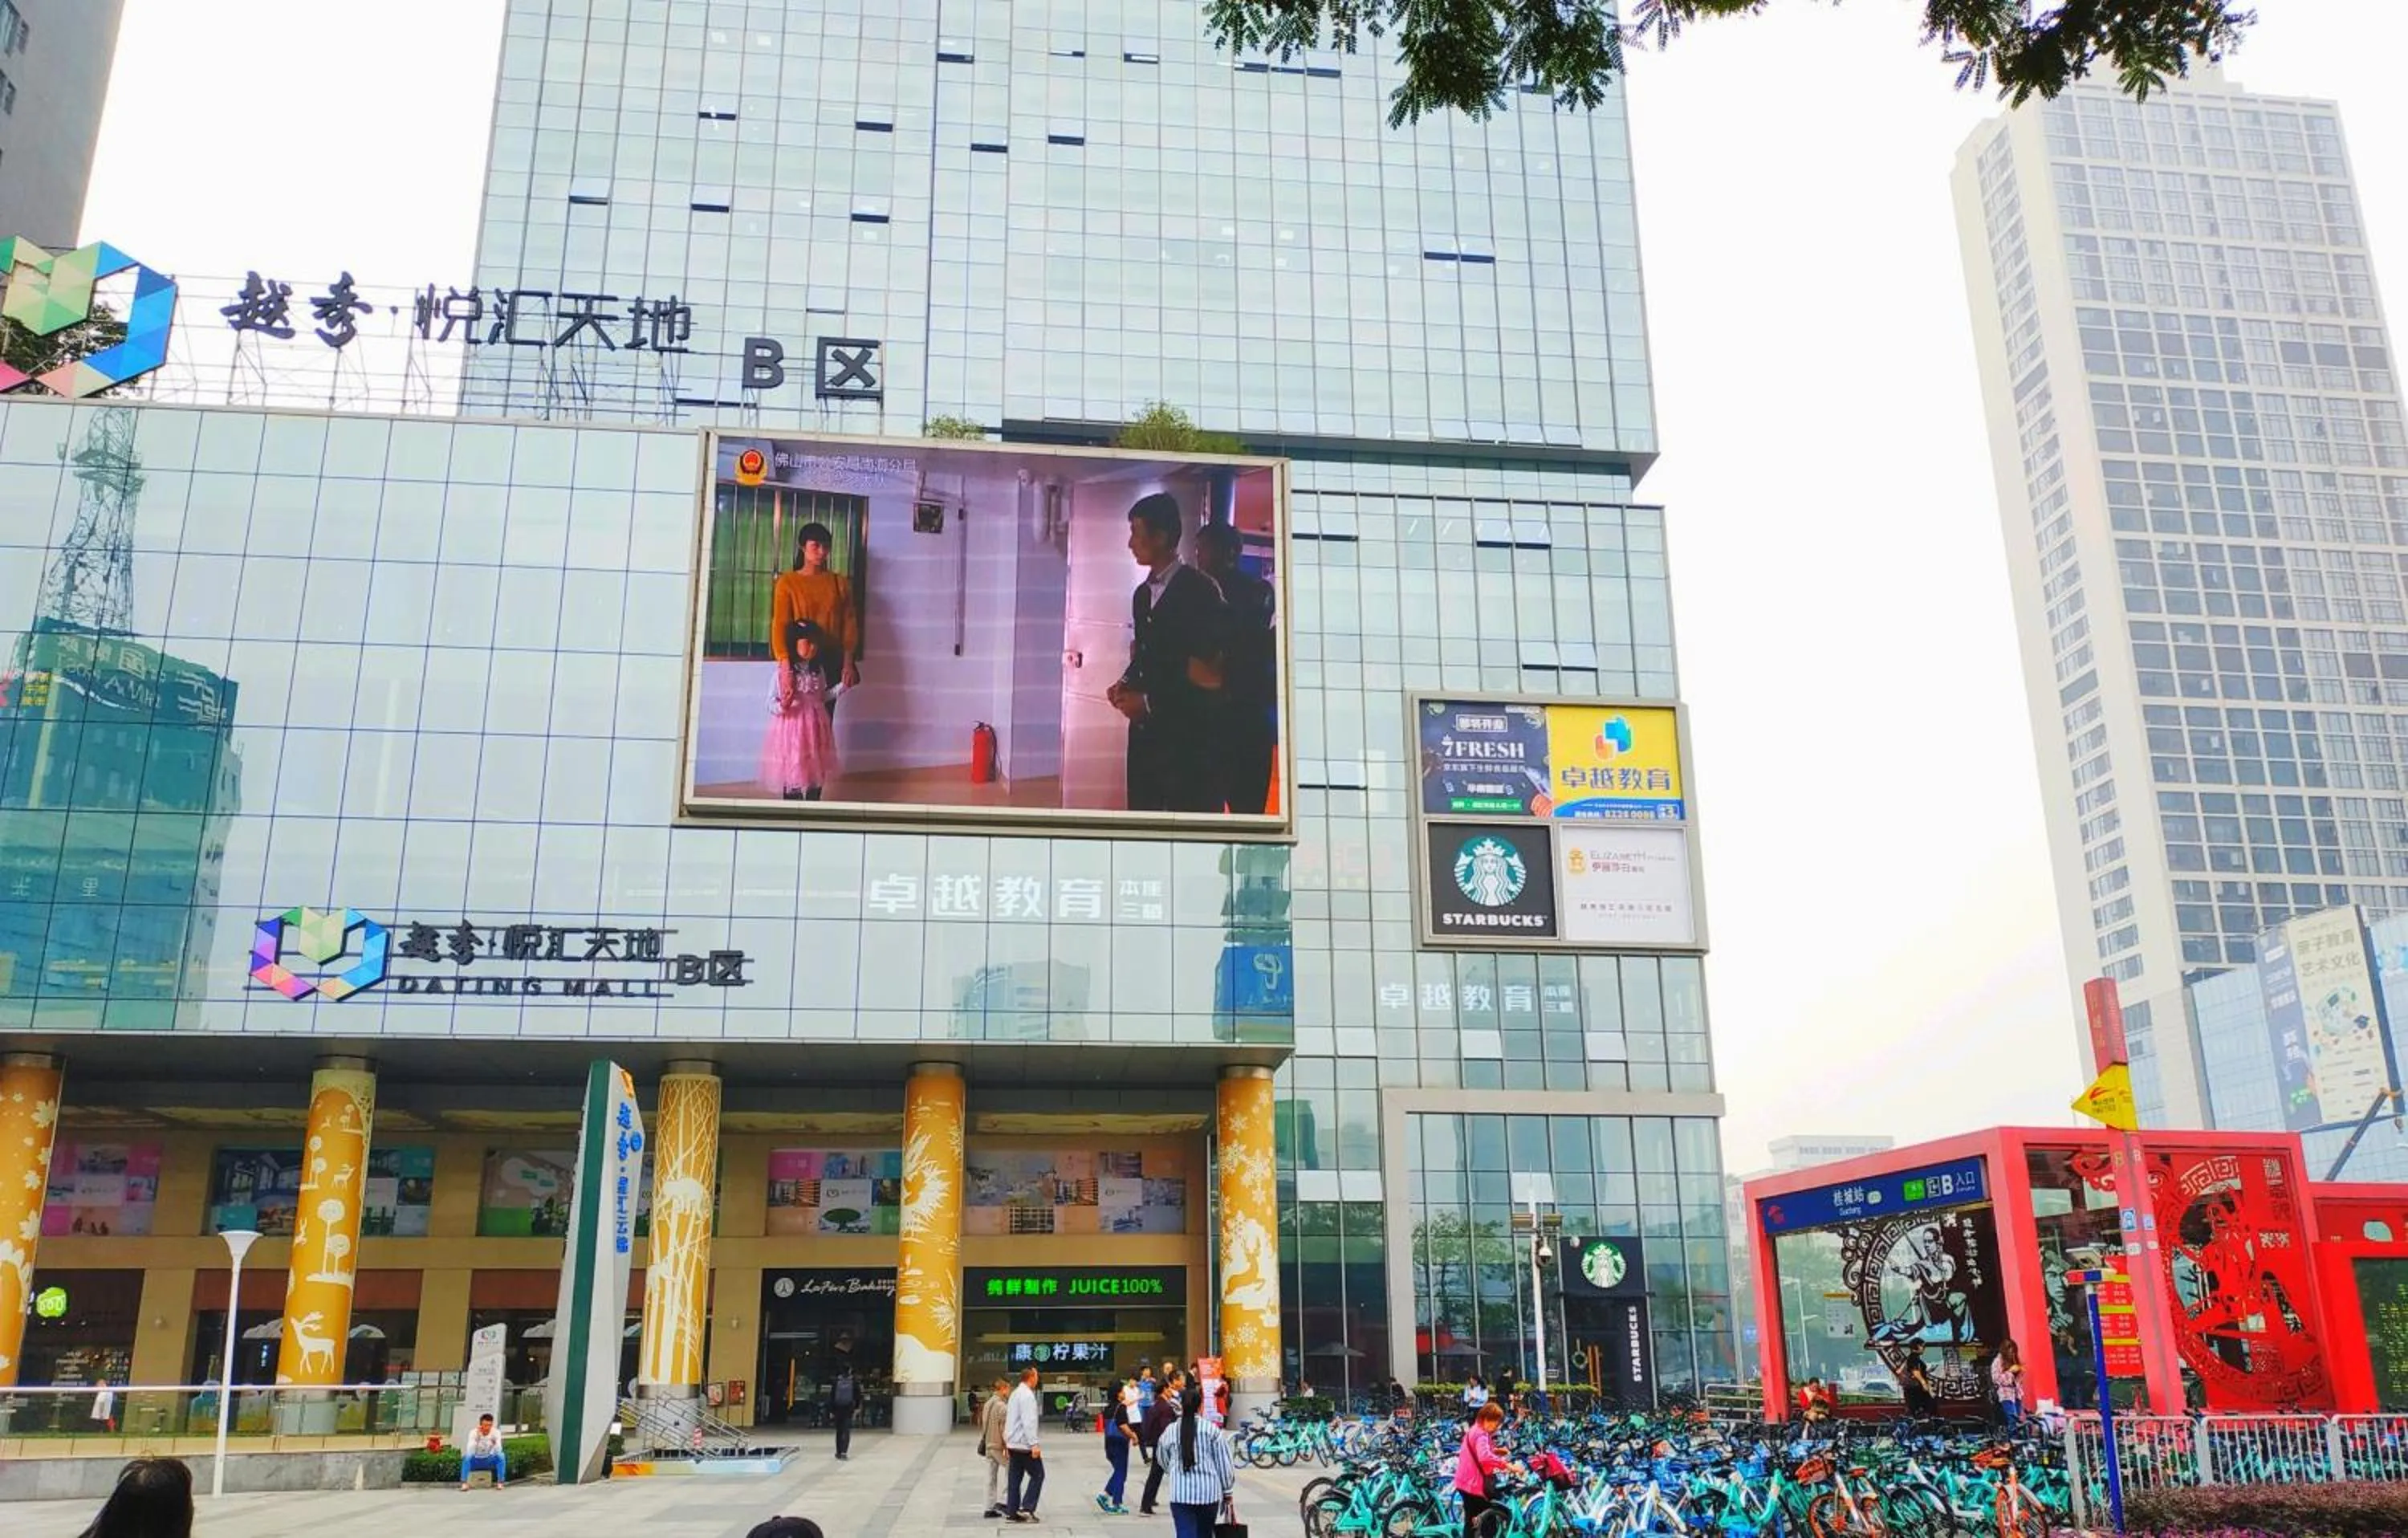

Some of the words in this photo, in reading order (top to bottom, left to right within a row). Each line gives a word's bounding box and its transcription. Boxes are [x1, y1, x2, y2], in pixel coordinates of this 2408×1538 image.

[1442, 734, 1524, 759] 7FRESH
[1561, 766, 1670, 791] 卓越教育
[868, 873, 1104, 919] 卓越教育
[1442, 913, 1544, 928] STARBUCKS
[1380, 983, 1532, 1011] 卓越教育
[1942, 1174, 1954, 1195] B
[1956, 1170, 1976, 1186] 入口
[1832, 1185, 1865, 1207] 桂城站
[1626, 1306, 1643, 1382] STARBUCKS
